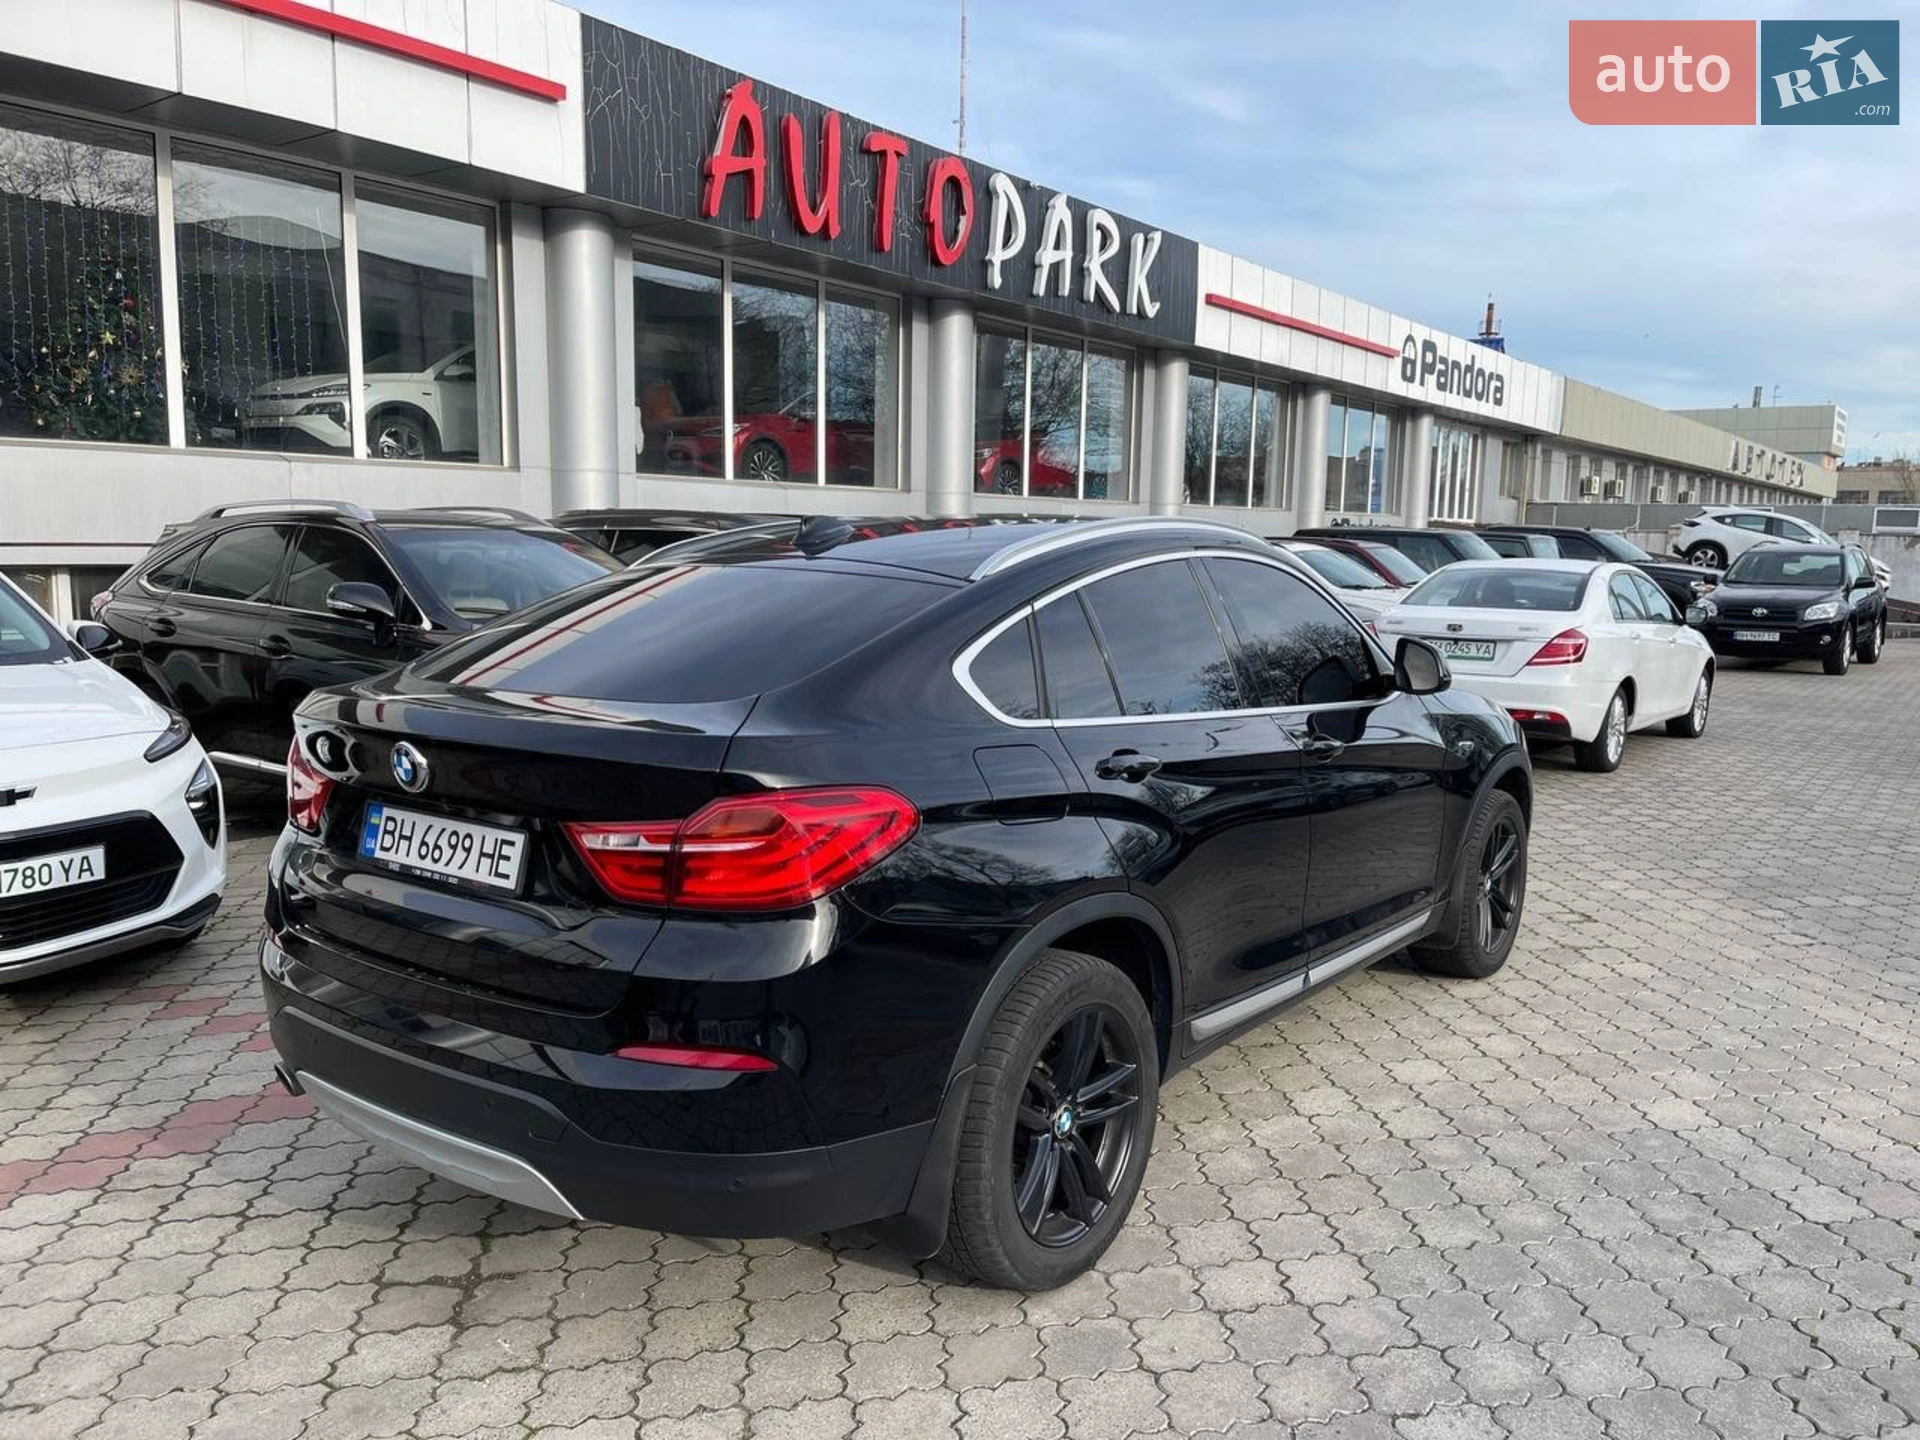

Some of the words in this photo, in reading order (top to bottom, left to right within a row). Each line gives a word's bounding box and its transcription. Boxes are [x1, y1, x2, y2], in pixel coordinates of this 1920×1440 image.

[1419, 338, 1505, 407] Pandora
[1475, 643, 1491, 656] YA
[59, 855, 94, 883] YA
[379, 815, 416, 858] BH
[417, 824, 474, 870] 6699
[475, 835, 516, 881] HE
